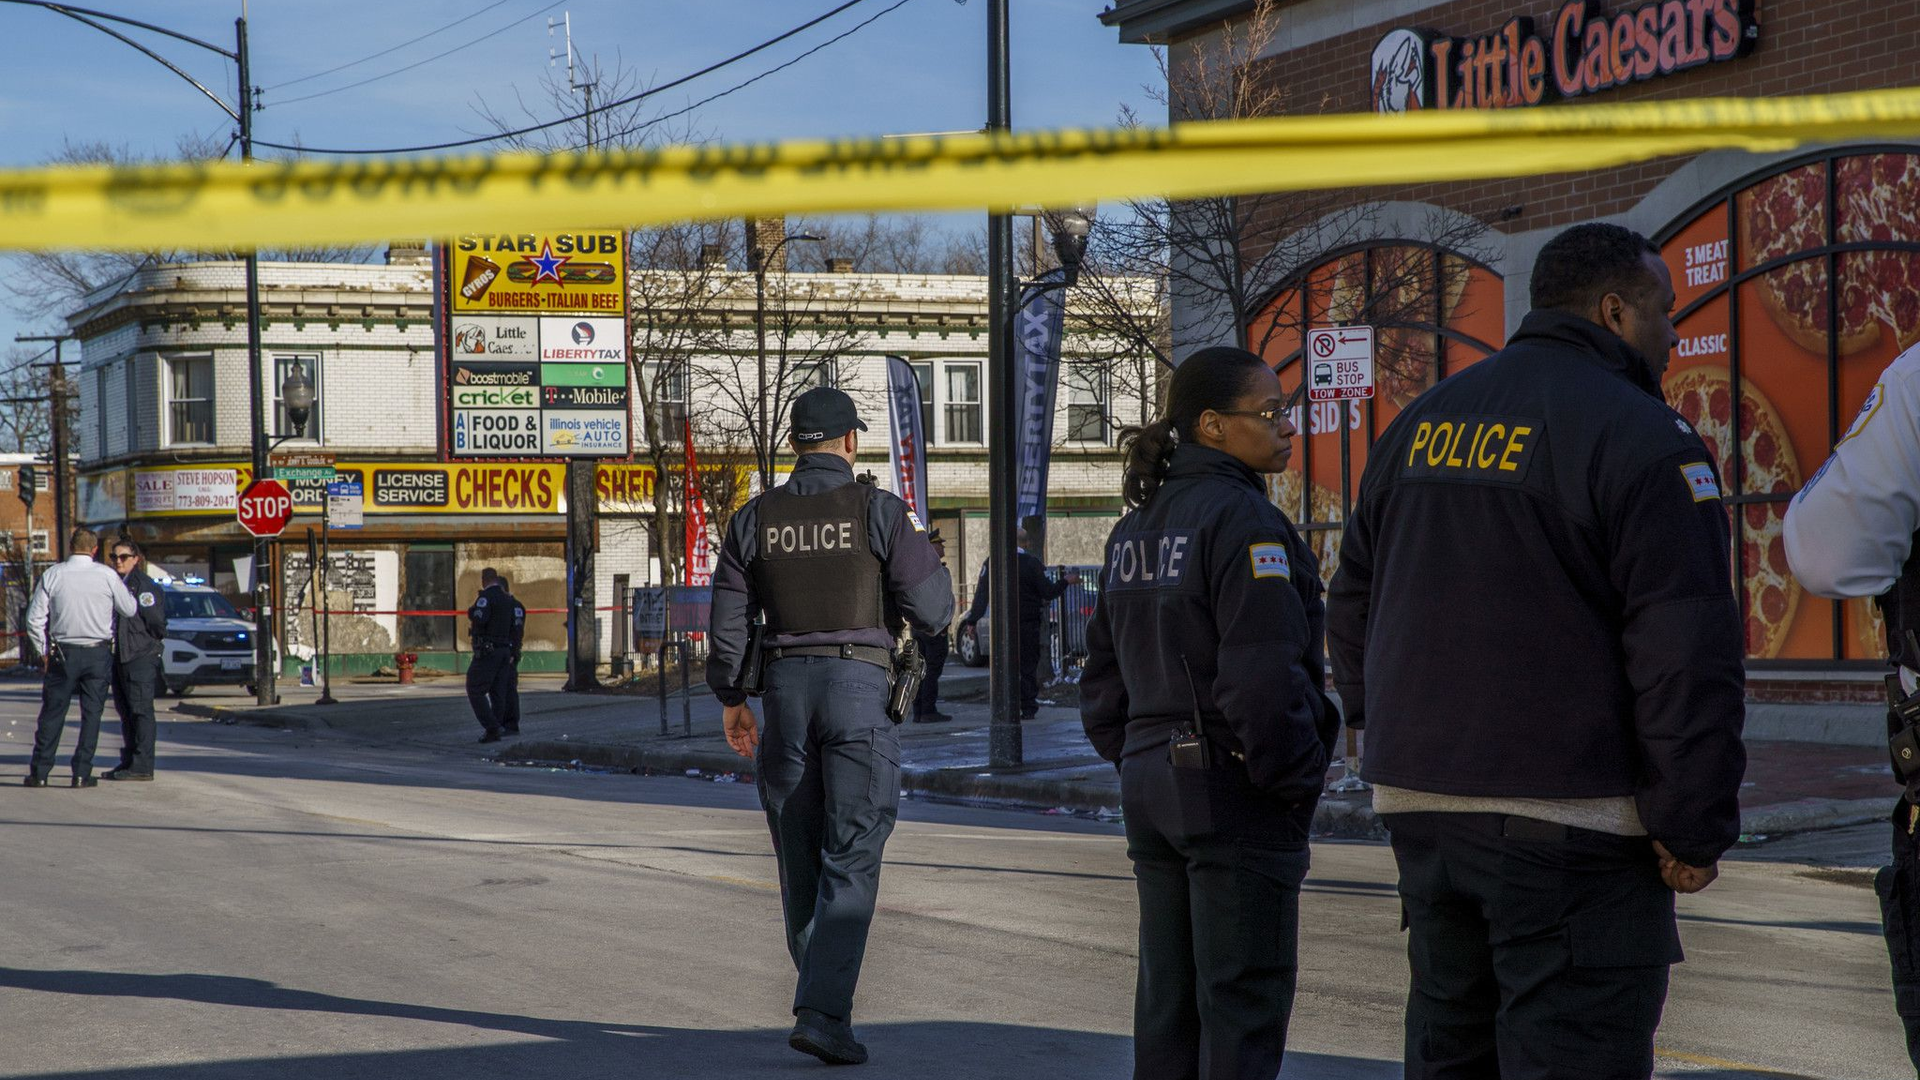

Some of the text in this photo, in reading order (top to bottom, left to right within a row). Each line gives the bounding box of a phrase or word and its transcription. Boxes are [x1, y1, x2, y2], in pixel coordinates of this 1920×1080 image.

[1433, 0, 1740, 109] Little Caesars
[458, 234, 618, 254] STAR SUB
[1685, 239, 1729, 267] 3 MEAT
[1686, 261, 1726, 287] TREAT
[462, 268, 496, 298] GYROS
[488, 292, 619, 309] BURGERS ITALIAN BEEF
[496, 326, 526, 339] Little
[1678, 333, 1727, 357] CLASSIC
[1337, 362, 1359, 373] BUS
[1337, 374, 1365, 386] STOP
[458, 387, 533, 405] cricket
[1314, 387, 1368, 398] TOW ZONE
[472, 416, 519, 431] FOOD
[525, 415, 537, 431] &
[550, 418, 621, 430] illinois vehicle
[473, 434, 537, 450] LIQUOR
[583, 431, 622, 441] AUTO
[1409, 421, 1532, 471] POLICE
[177, 472, 200, 485] STEVE
[202, 472, 234, 485] HOPSON
[279, 468, 322, 477] Exchange
[136, 481, 173, 490] SALE
[377, 474, 444, 488] LICENSE
[455, 468, 552, 510] CHECKS
[596, 469, 657, 508] SHED
[291, 489, 323, 502] ORD
[377, 489, 445, 503] SERVICE
[241, 497, 290, 519] STOP
[766, 522, 851, 553] POLICE
